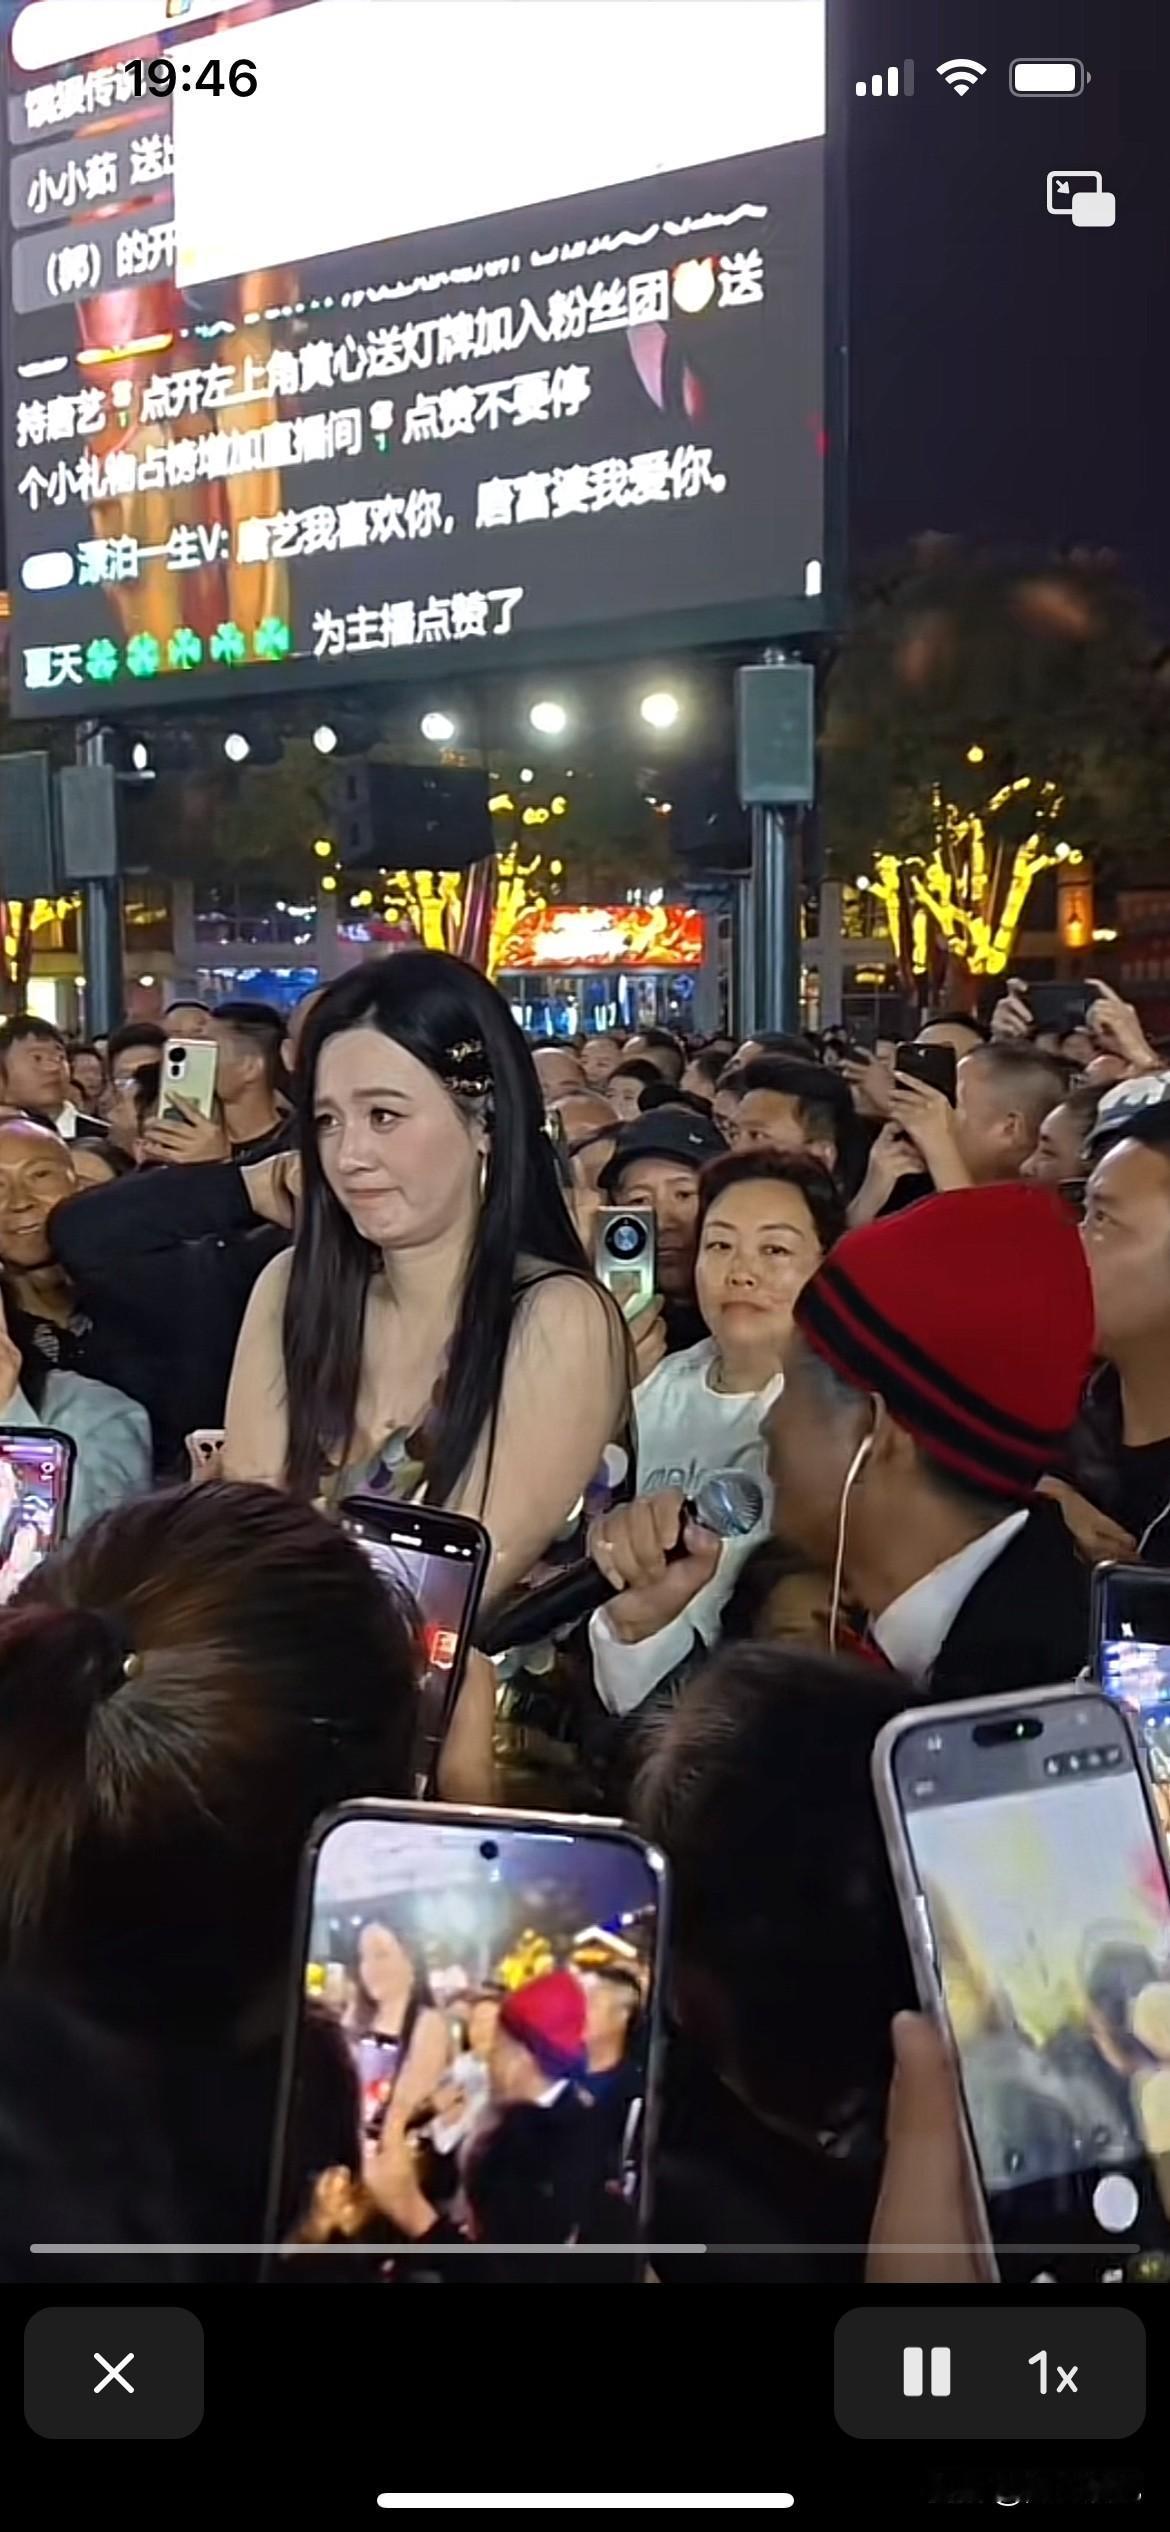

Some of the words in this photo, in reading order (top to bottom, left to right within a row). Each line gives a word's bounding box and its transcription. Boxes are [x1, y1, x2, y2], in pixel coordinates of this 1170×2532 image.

[718, 248, 764, 307] 送
[402, 364, 591, 444] 点赞不要停
[312, 587, 523, 656] 为主播点赞了
